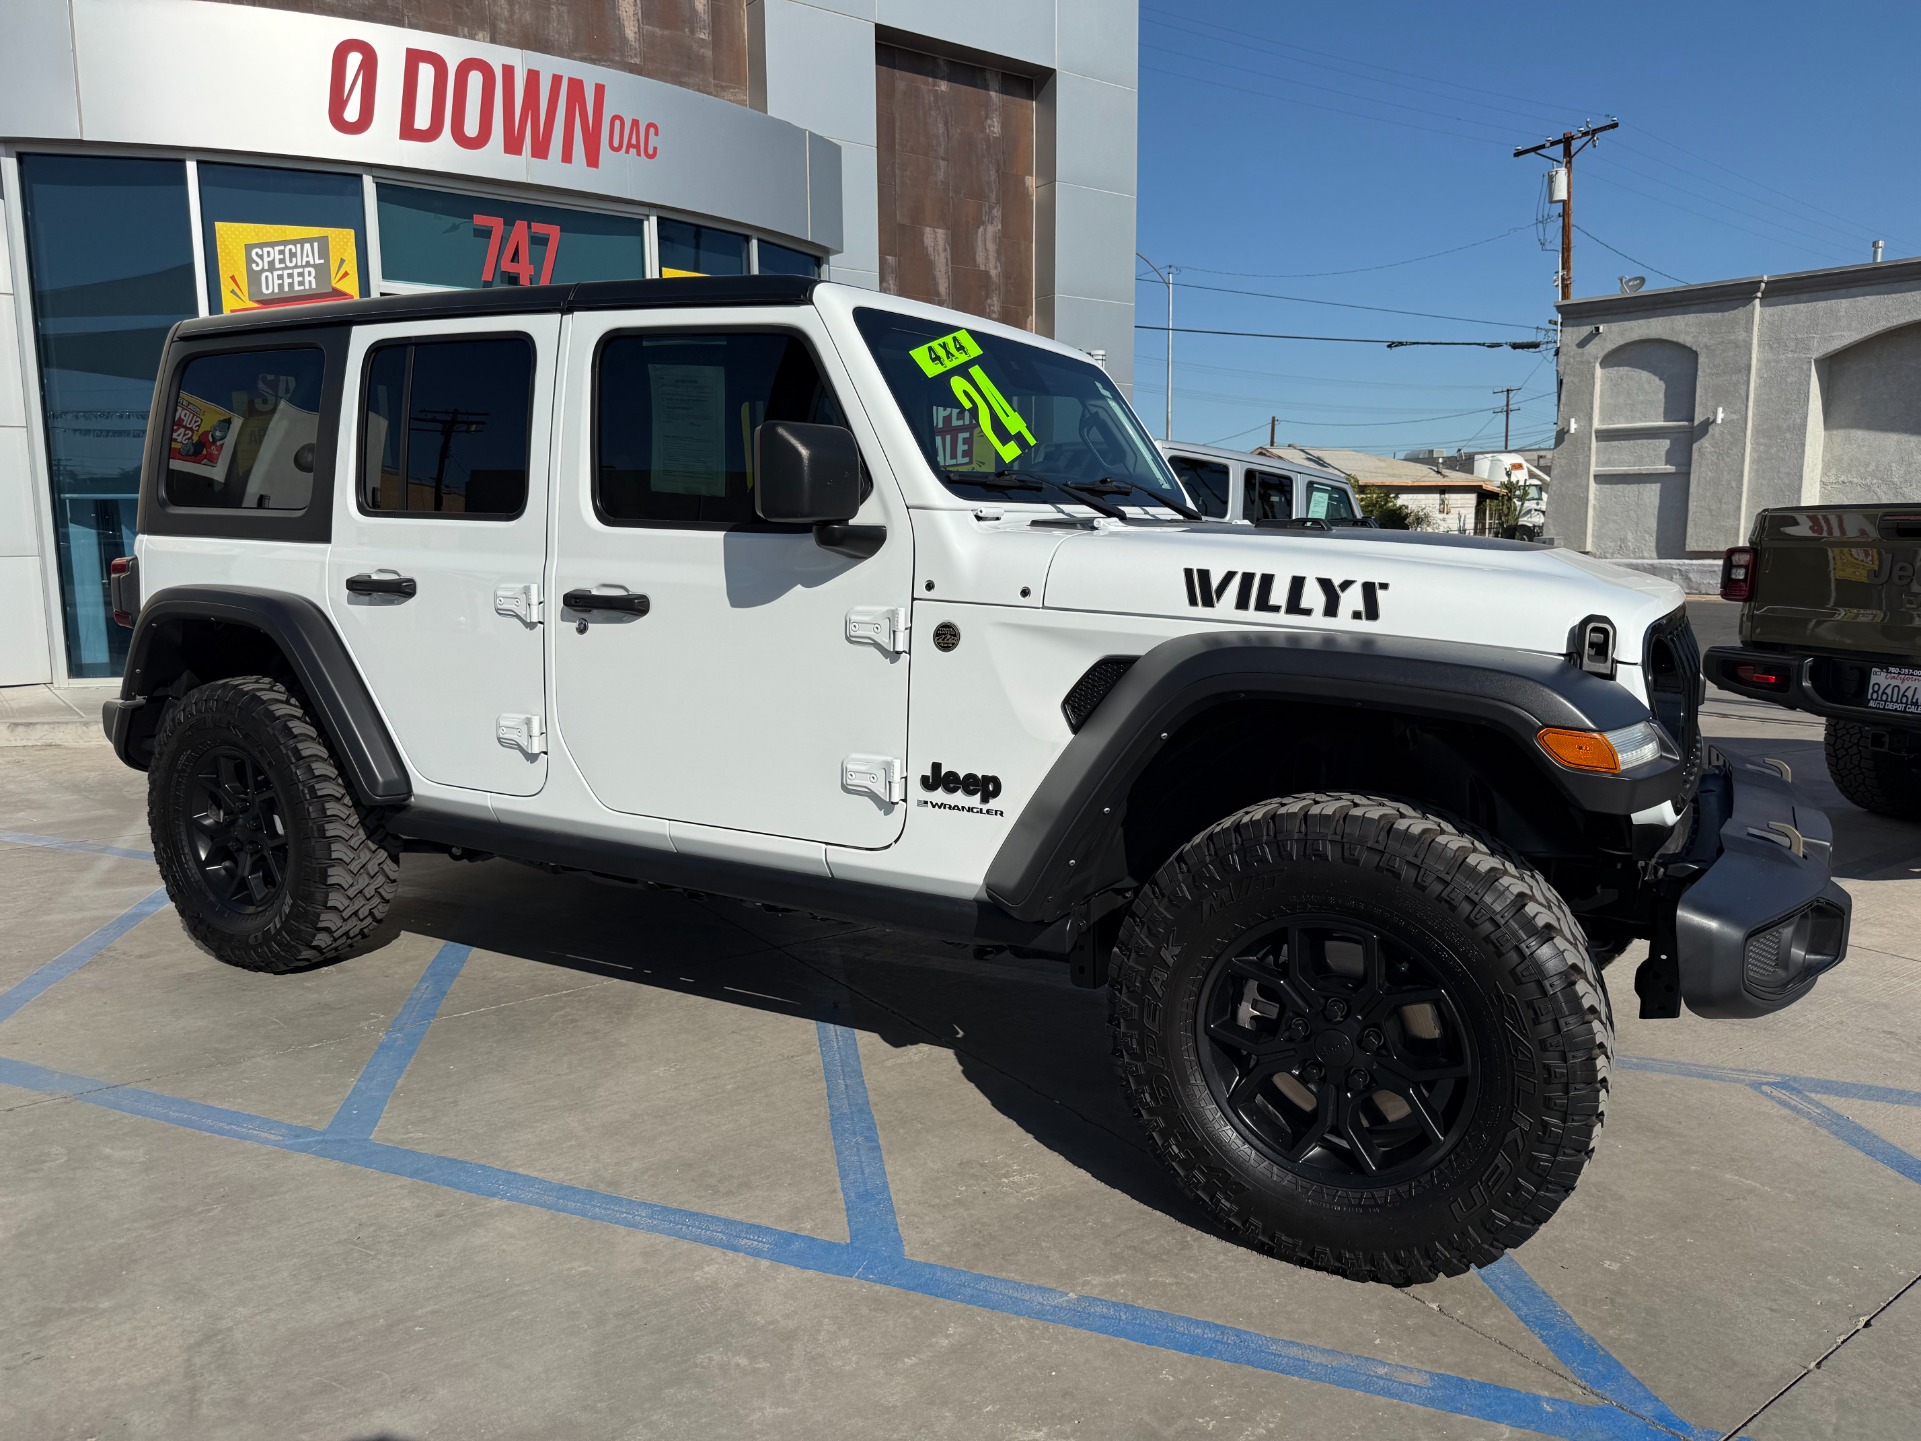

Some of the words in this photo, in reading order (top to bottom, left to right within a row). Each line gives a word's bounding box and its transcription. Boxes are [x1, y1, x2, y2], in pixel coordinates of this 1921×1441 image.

[399, 47, 606, 170] DOWN
[608, 114, 660, 160] OAC
[251, 242, 325, 271] SPECIAL
[473, 213, 561, 286] 747
[261, 267, 317, 294] OFFER
[950, 364, 1038, 464] 24
[1183, 567, 1390, 622] WILLYS
[1868, 700, 1885, 708] AUTO
[1885, 702, 1907, 711] DEPOT
[920, 761, 1002, 805] Jeep
[929, 800, 1004, 817] WRANGLER
